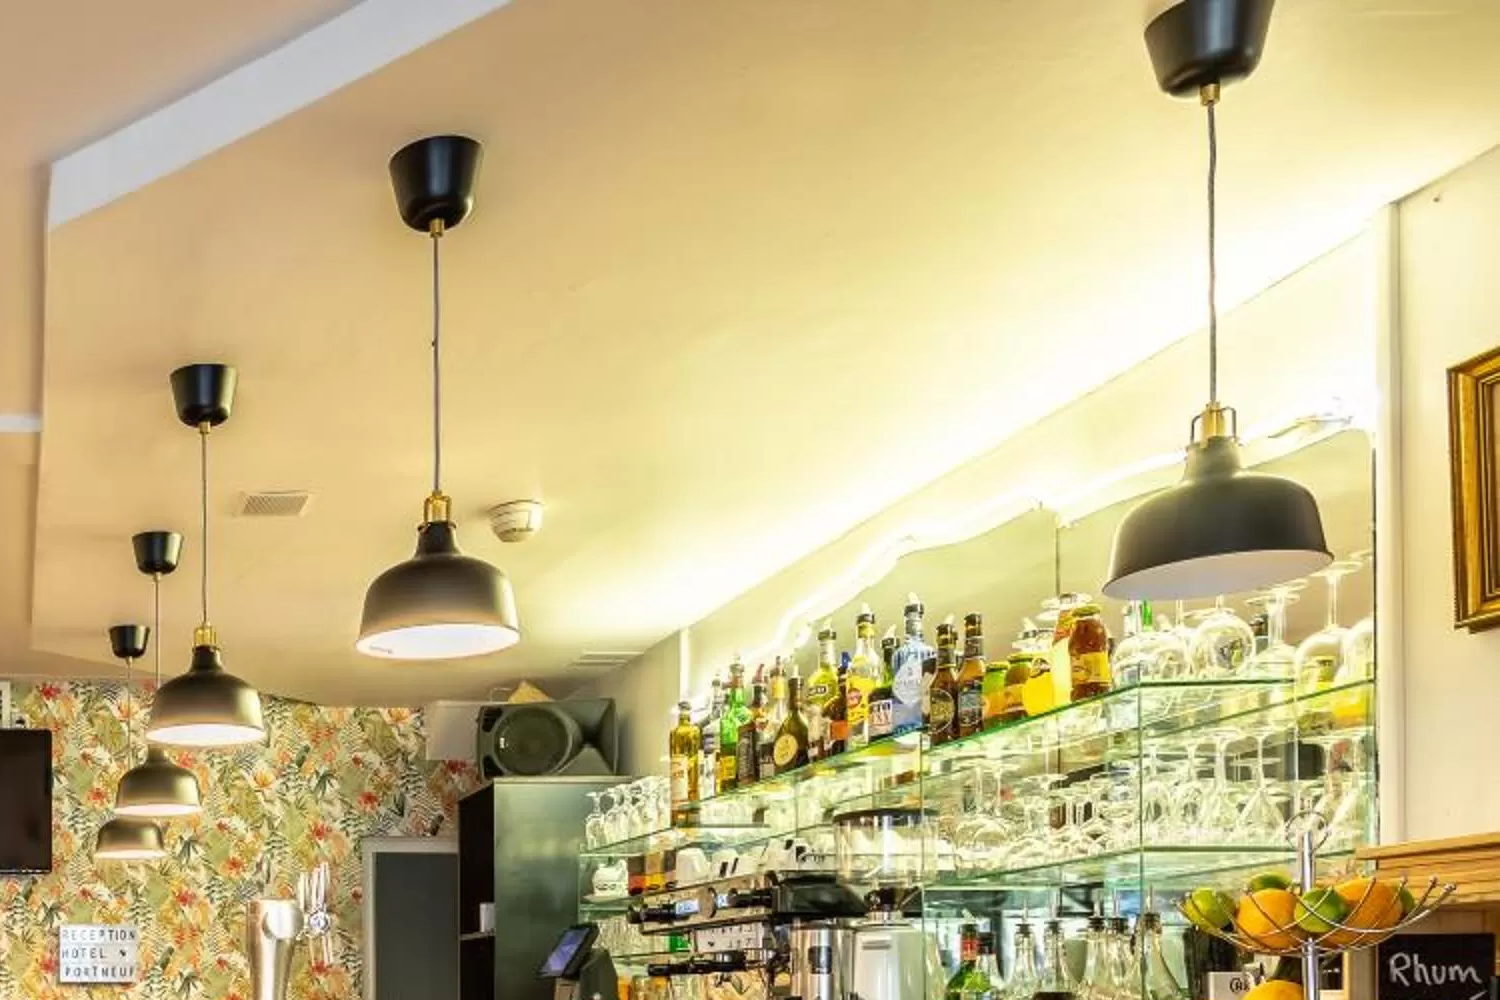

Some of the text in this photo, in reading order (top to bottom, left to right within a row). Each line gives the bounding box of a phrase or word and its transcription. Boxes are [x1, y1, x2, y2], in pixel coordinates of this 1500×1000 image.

[62, 929, 135, 941] RECEPTION
[61, 947, 107, 959] HOTEL
[1389, 952, 1482, 986] Rhum
